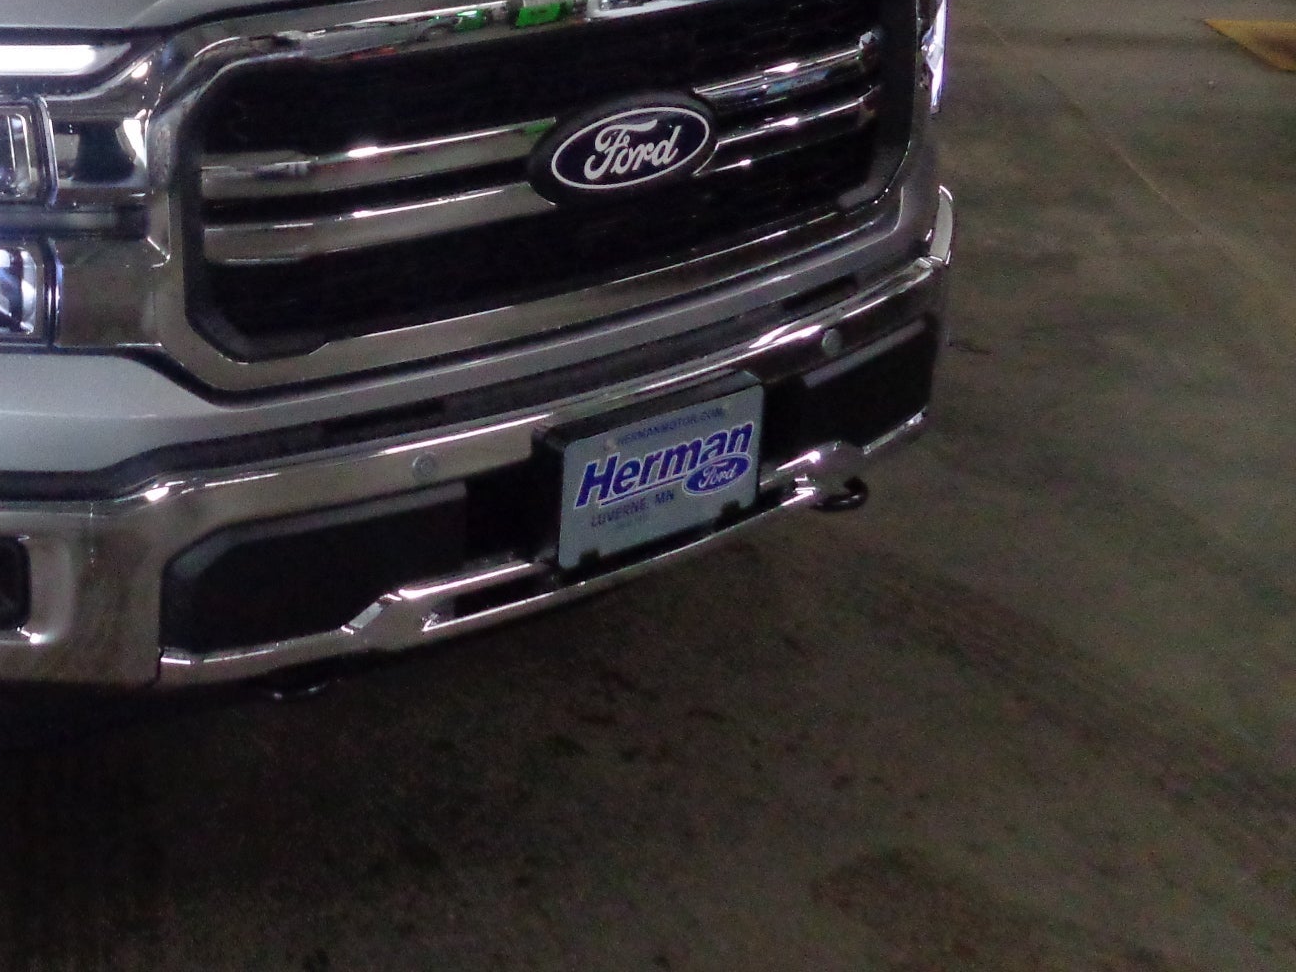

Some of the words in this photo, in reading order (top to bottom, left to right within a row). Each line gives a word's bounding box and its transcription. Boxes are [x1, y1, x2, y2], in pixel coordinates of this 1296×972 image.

[584, 119, 682, 180] Ford
[574, 421, 754, 510] Herman
[699, 462, 738, 489] Ford
